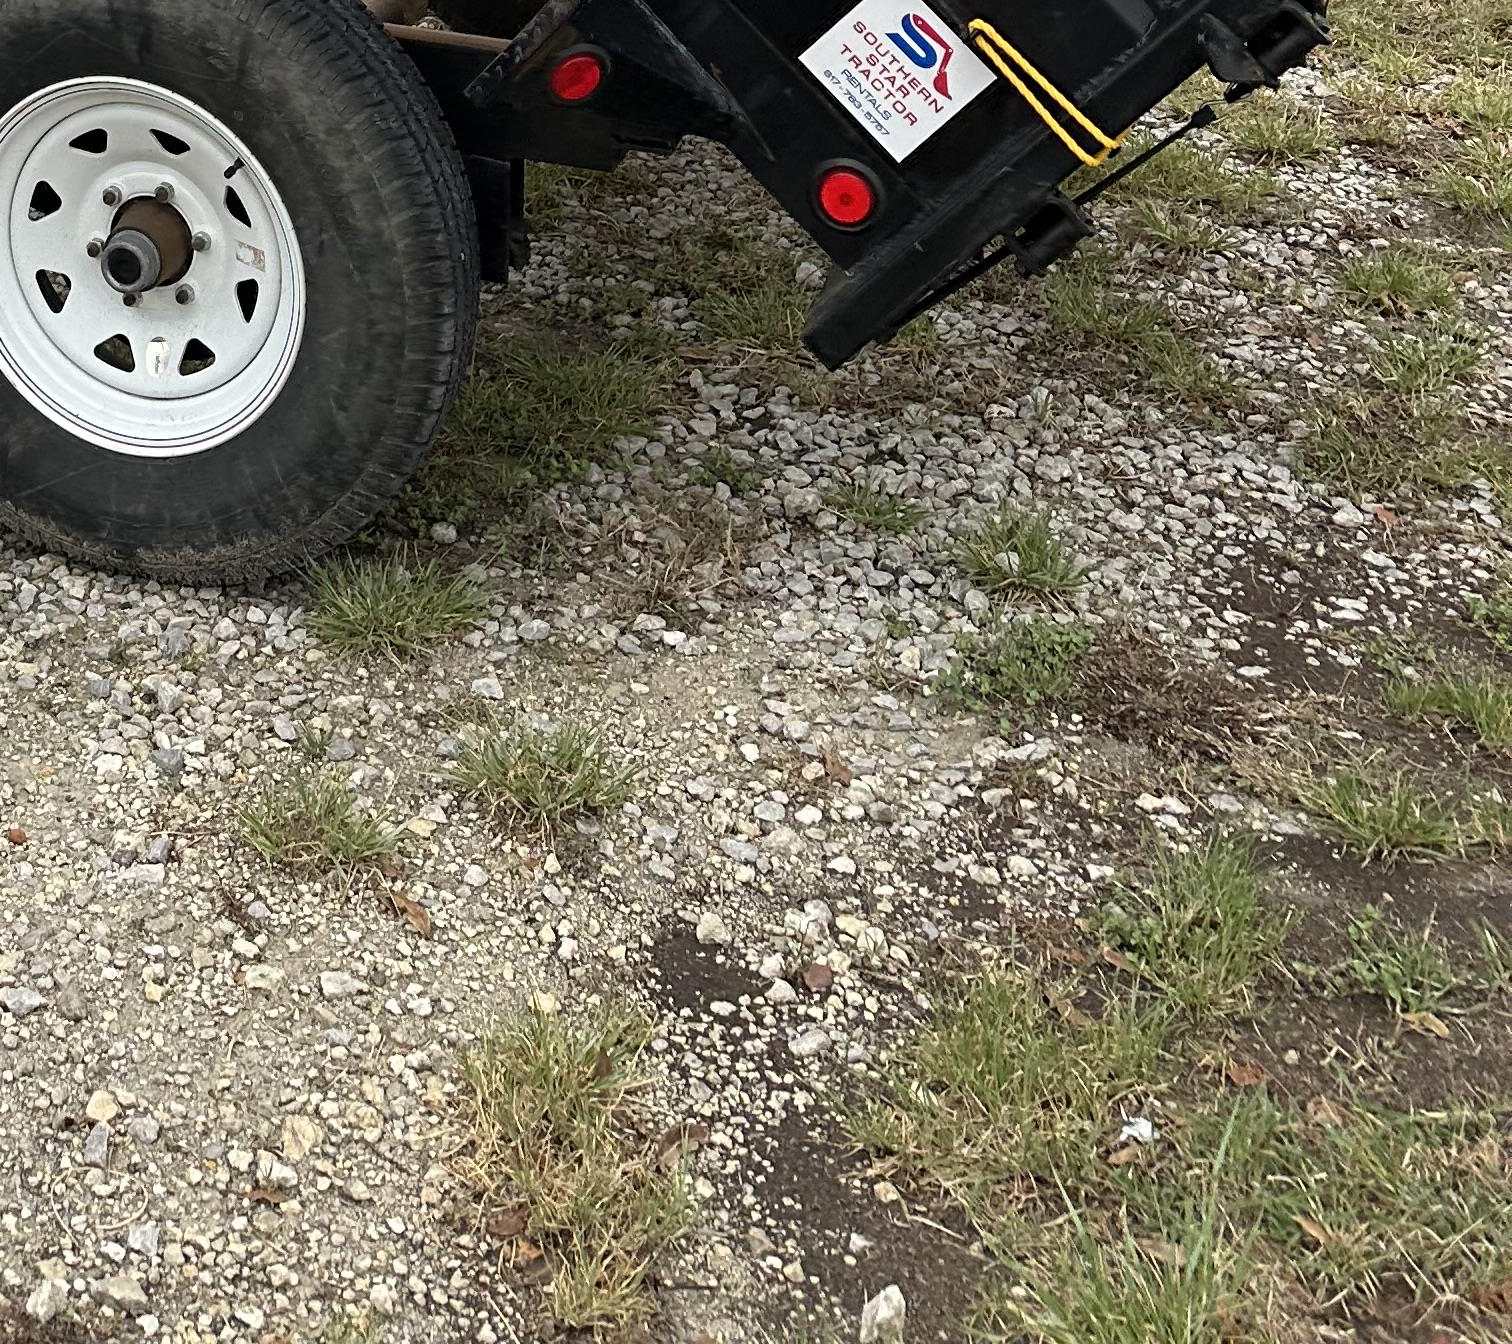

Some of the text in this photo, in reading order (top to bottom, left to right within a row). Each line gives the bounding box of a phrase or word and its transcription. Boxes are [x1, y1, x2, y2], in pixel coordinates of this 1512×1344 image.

[839, 43, 917, 126] TRACTOR
[840, 68, 892, 121] RENTALS
[851, 19, 944, 114] SOUTHERN
[865, 53, 911, 99] STAR
